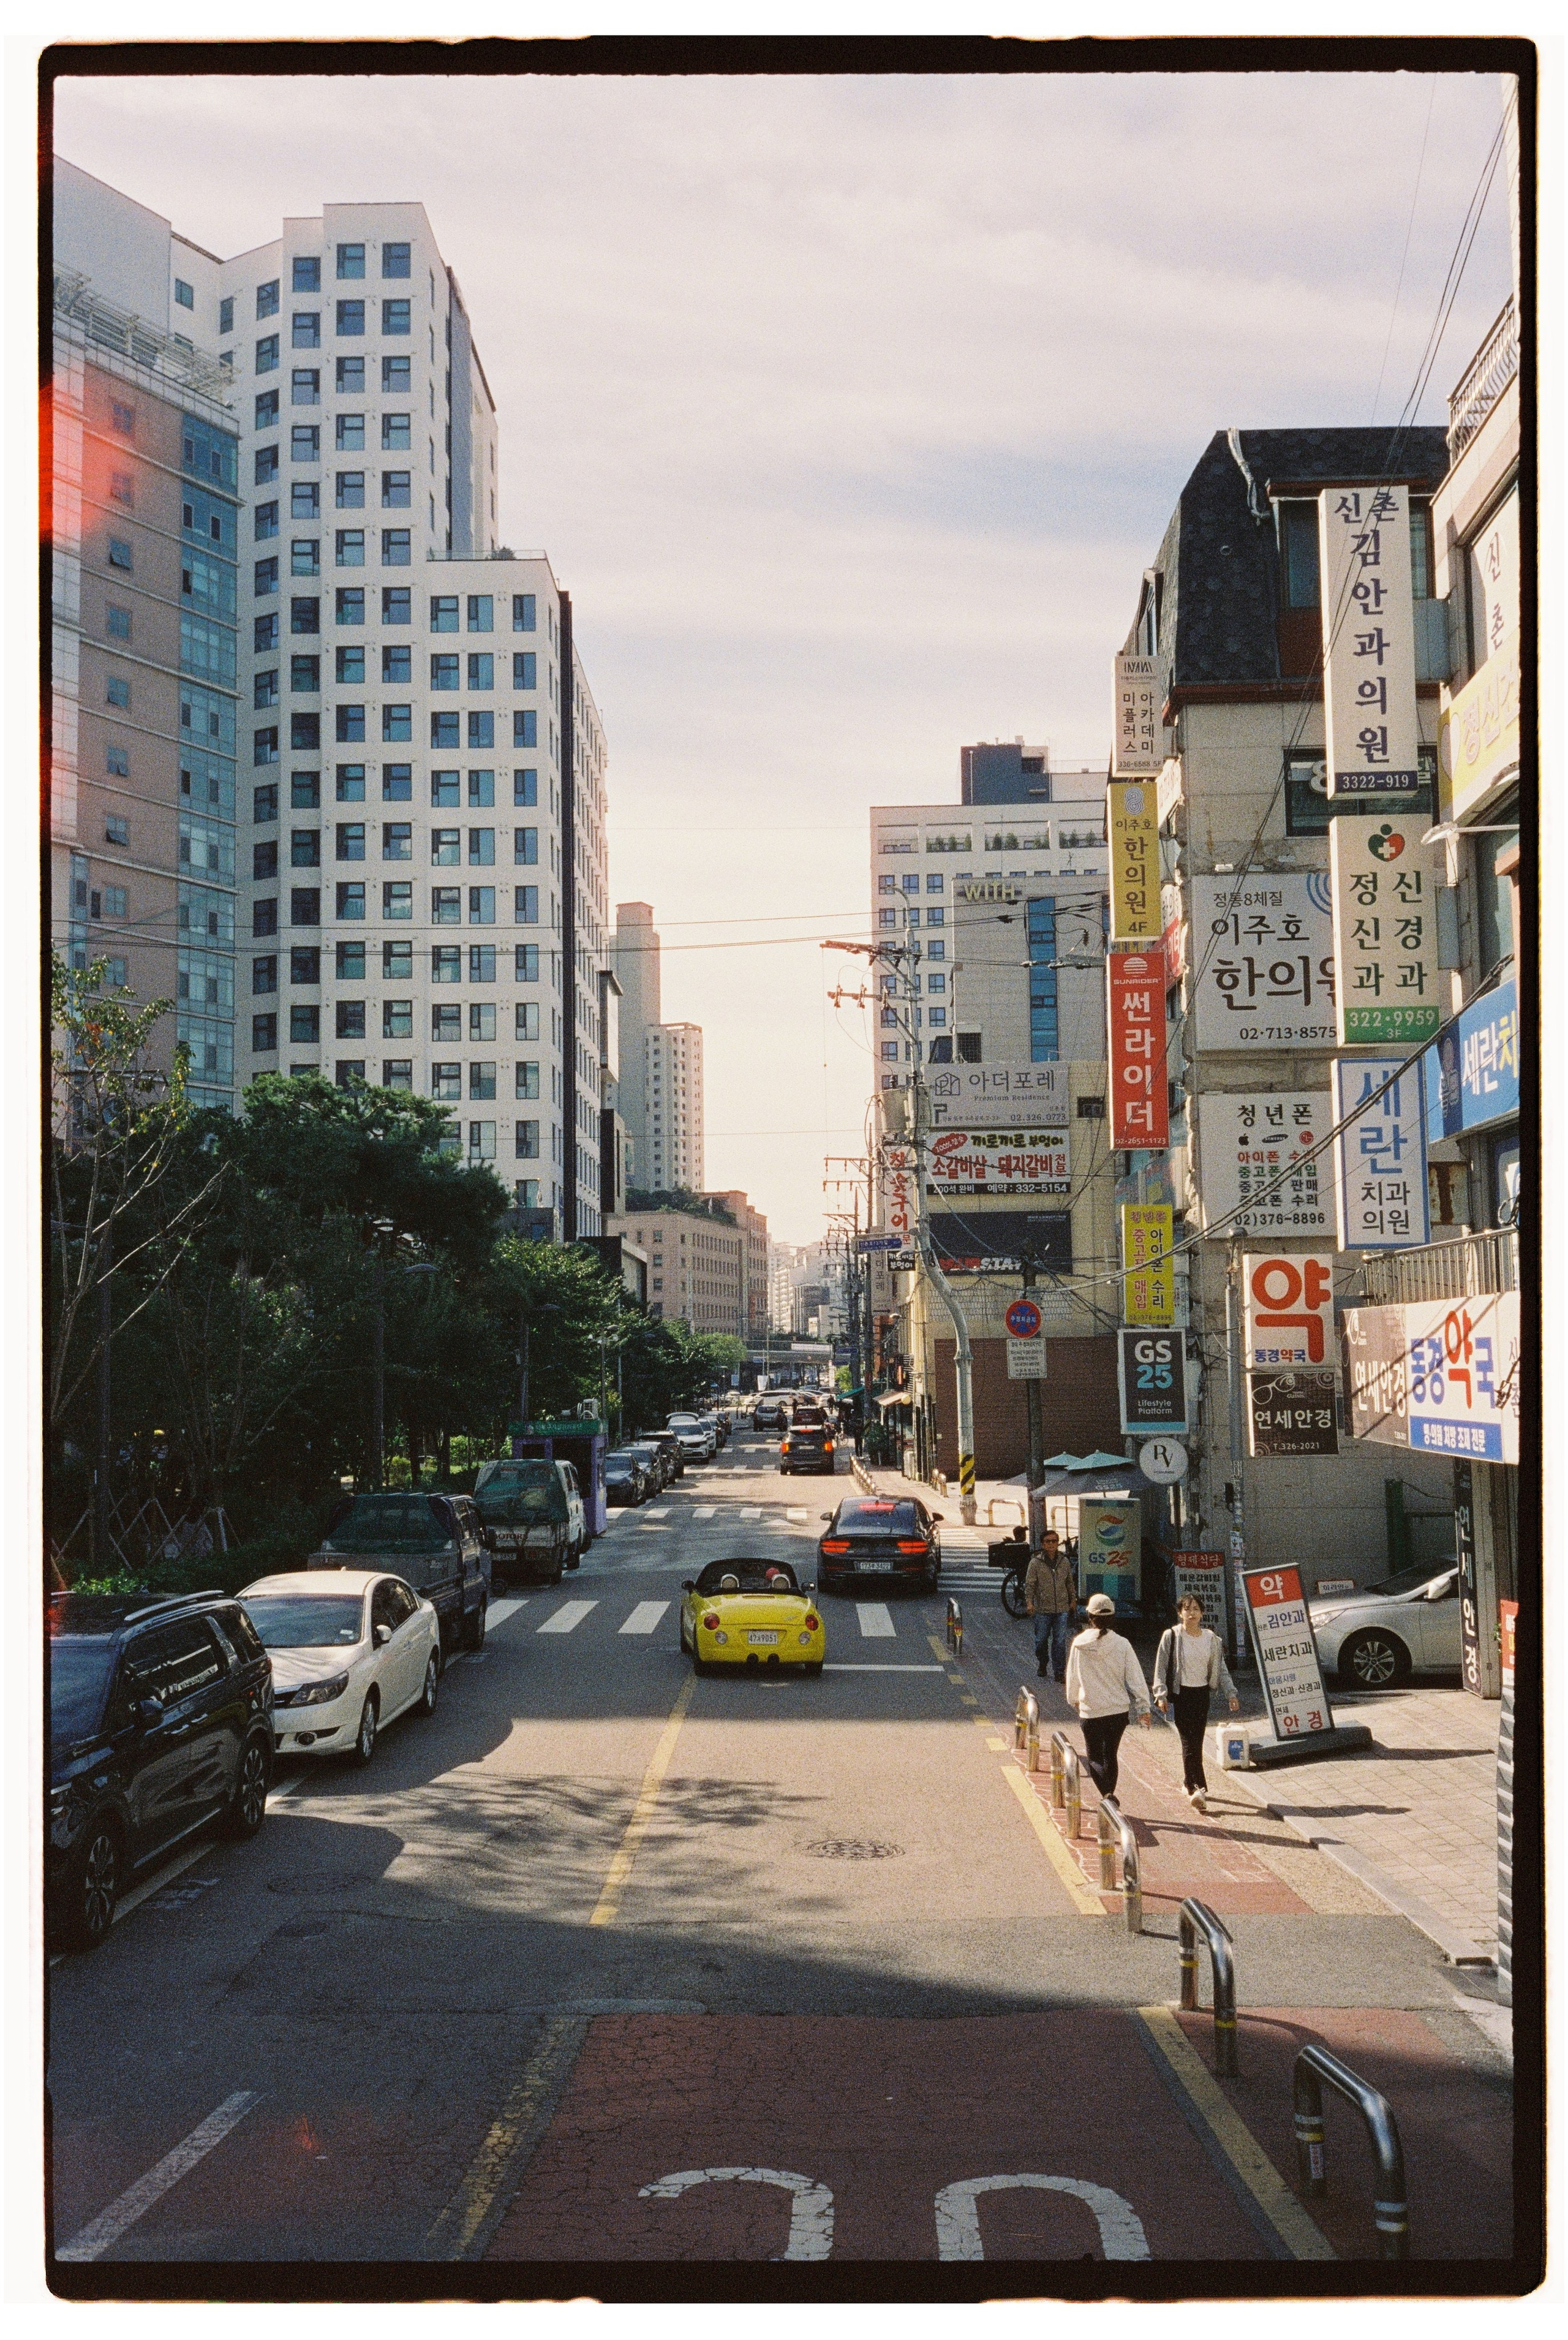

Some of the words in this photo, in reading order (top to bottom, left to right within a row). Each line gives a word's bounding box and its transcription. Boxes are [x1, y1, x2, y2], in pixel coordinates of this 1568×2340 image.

[1335, 492, 1398, 524] 신촌
[1350, 529, 1390, 764] 김안과의원
[1123, 692, 1137, 753] 미플러스
[1140, 691, 1155, 754] 아카데미
[1116, 817, 1154, 832] 이주호
[1124, 836, 1148, 915] 한의원
[963, 881, 1016, 900] WITH
[1128, 921, 1147, 933] 4F
[1212, 912, 1310, 946] 이주호
[1351, 872, 1384, 997] 정신과
[1392, 871, 1428, 996] 신경과
[1122, 991, 1155, 1131] 썬라이더
[968, 1070, 1054, 1093] 아더포레
[1237, 1103, 1313, 1127] 청년폰
[1354, 1069, 1408, 1175] 세란
[1028, 1134, 1064, 1148] 부엉이
[1055, 1153, 1067, 1177] 전문
[1237, 1151, 1280, 1164] 아이폰
[987, 1184, 1008, 1193] 예약
[1016, 1184, 1068, 1193] 332-5154
[1290, 1179, 1317, 1192] 판매
[1361, 1180, 1411, 1206] 치과
[1291, 1194, 1317, 1207] 수리
[1235, 1212, 1325, 1226] 02)376-8896
[1362, 1209, 1411, 1235] 의원
[1151, 1279, 1164, 1309] 수리
[1251, 1259, 1332, 1364] 약
[1134, 1340, 1173, 1364] GS
[1255, 1348, 1306, 1363] 동경약국
[1410, 1308, 1496, 1410] 동경약국
[1136, 1364, 1174, 1389] 25
[1355, 1360, 1406, 1418] 연세안경
[1137, 1400, 1172, 1408] Lifestyle
[1255, 1410, 1332, 1430] 연세안경
[1273, 1442, 1320, 1451] T.326-2021
[1088, 1550, 1133, 1568] GS25
[1177, 1553, 1220, 1567] 형제식당
[1259, 1574, 1284, 1600] 약
[1267, 1609, 1305, 1629] 김안과
[1264, 1640, 1313, 1663] 세란치과
[1283, 1708, 1324, 1735] 안경
